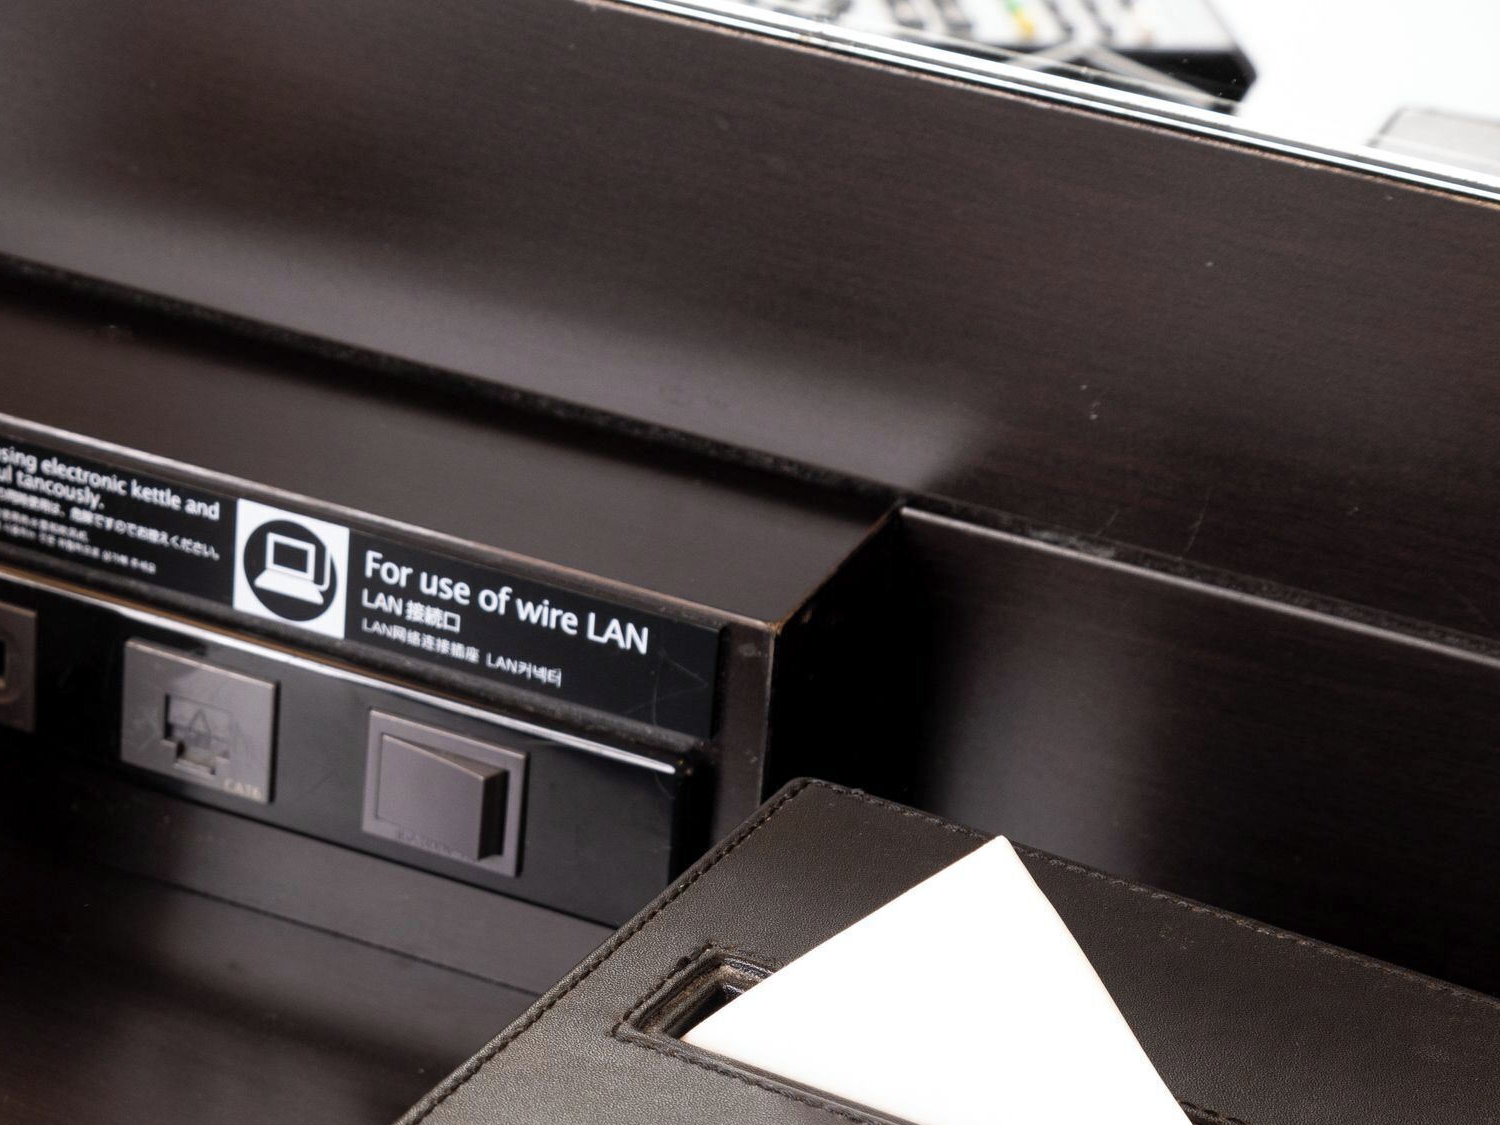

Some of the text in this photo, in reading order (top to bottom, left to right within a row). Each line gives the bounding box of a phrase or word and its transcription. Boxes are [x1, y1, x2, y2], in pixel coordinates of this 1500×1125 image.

[40, 456, 128, 496] electronic
[130, 478, 182, 511] kettle
[184, 500, 221, 522] and
[361, 587, 462, 635] LAN 接続口
[364, 549, 650, 656] For use of wire LAN
